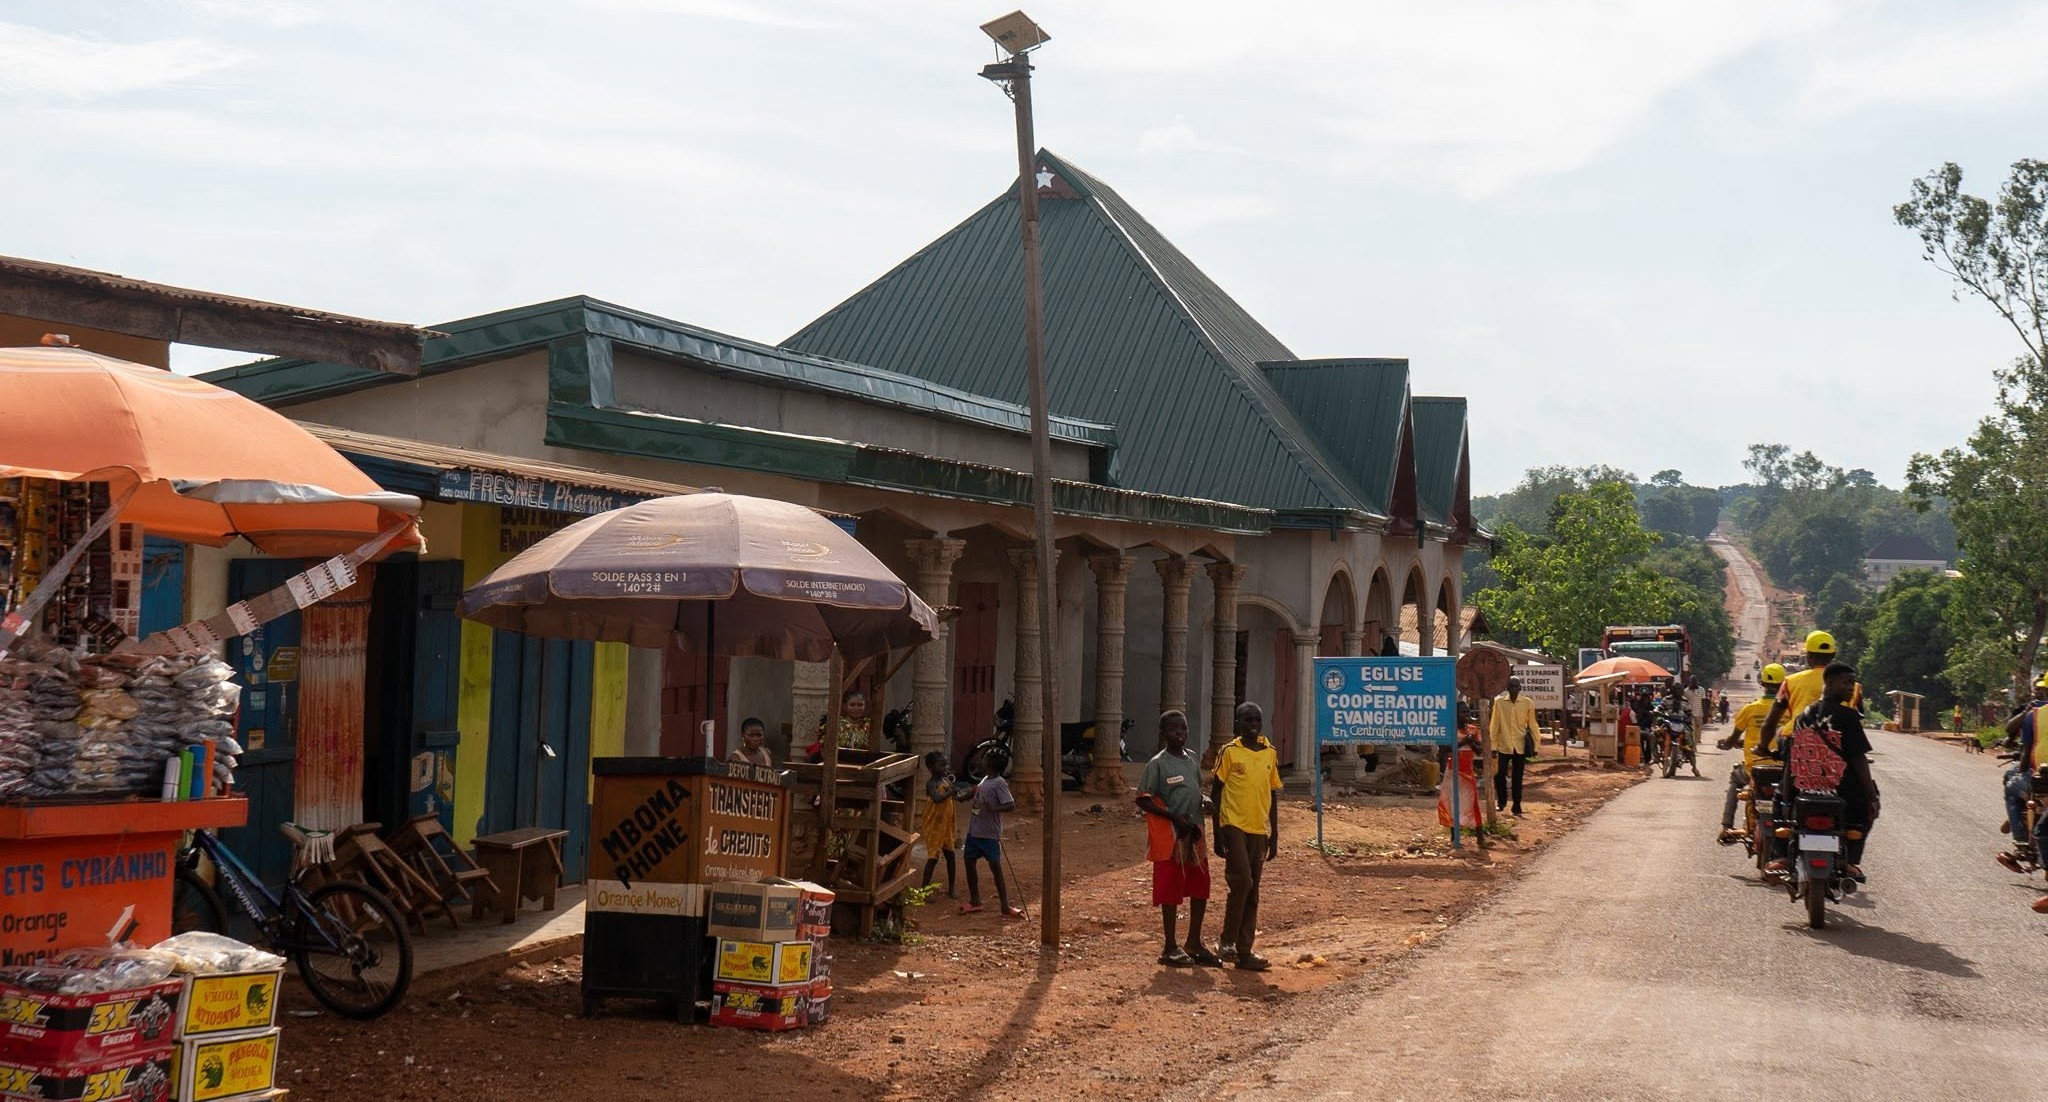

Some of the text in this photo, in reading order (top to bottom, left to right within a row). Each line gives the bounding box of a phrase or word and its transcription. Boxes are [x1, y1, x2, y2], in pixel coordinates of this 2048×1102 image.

[470, 472, 612, 514] FRESNEL Pharma
[592, 572, 687, 582] SOLDE PASS 3 EN 1
[786, 580, 810, 590] SOLDE
[1361, 666, 1424, 681] EGLISE
[1327, 693, 1447, 709] COOPERATION
[1332, 724, 1446, 739] En Centrafrique YALOKE
[1334, 710, 1438, 726] EVANGELIQUE
[728, 763, 750, 778] DEPOT
[709, 783, 778, 821] TRANSFERT
[601, 779, 692, 862] MBOMA
[615, 817, 688, 890] PHONE
[720, 830, 772, 858] CREDITS
[4, 850, 167, 896] ETS CYRIANHO
[218, 864, 262, 921] SCHWINN
[598, 890, 683, 912] Orange Money
[2, 911, 68, 943] Orange
[85, 1000, 137, 1036] 3X
[101, 1031, 136, 1046] ENERGY
[82, 1066, 131, 1101] 3X
